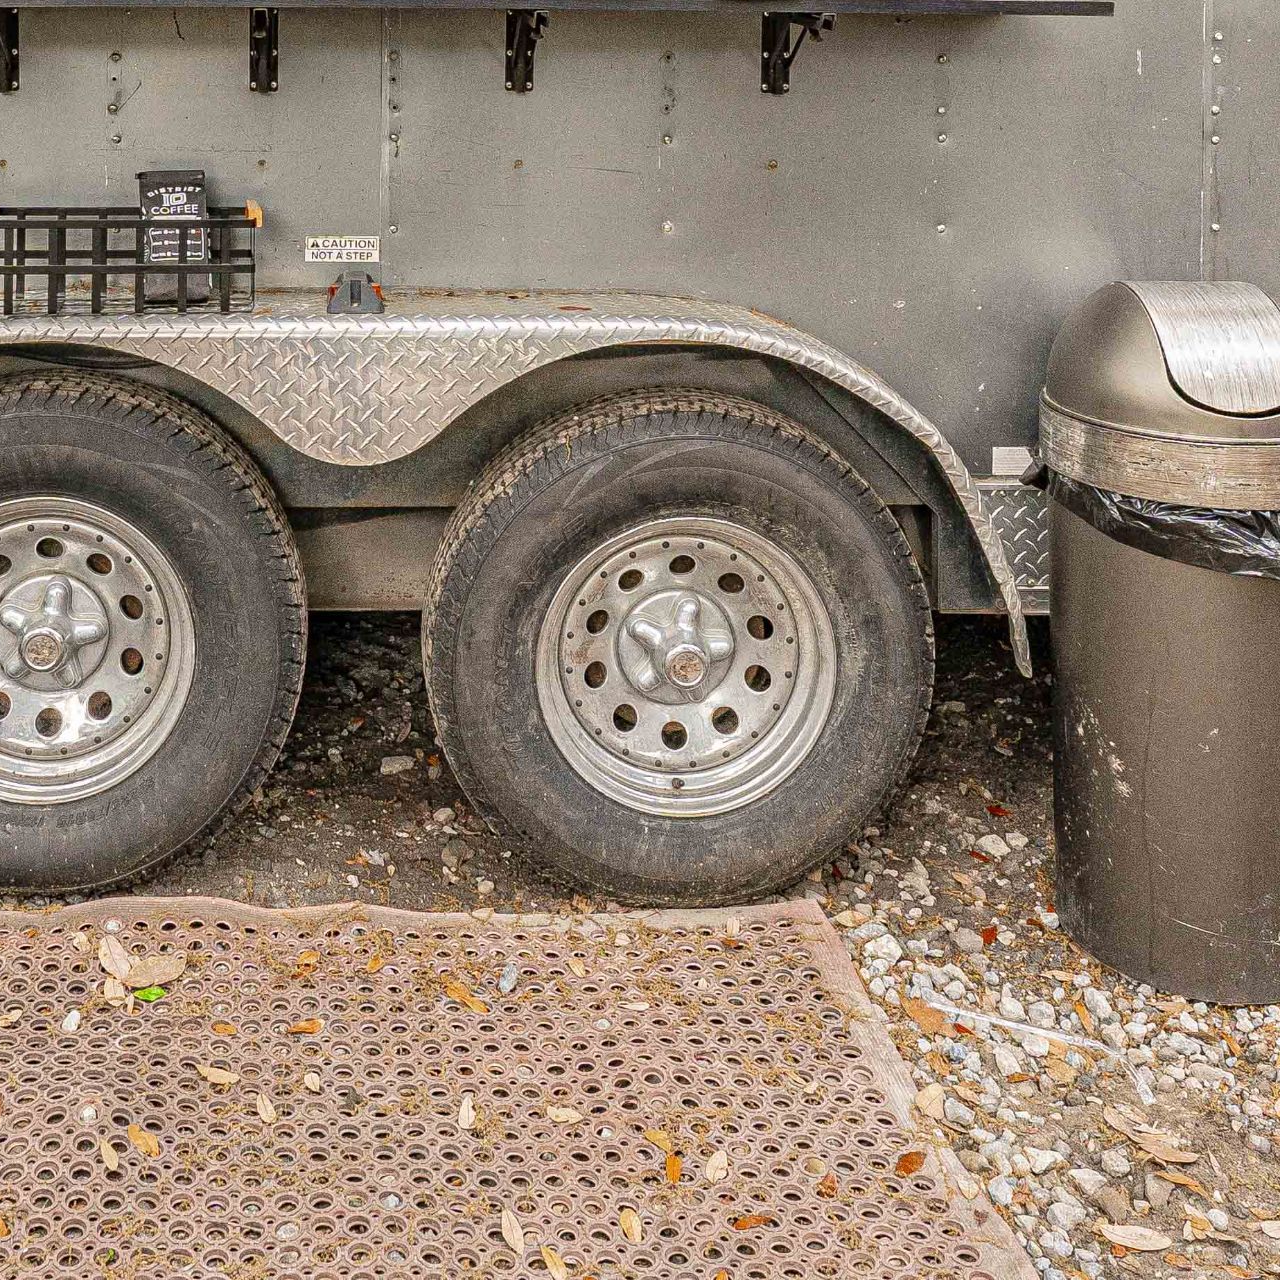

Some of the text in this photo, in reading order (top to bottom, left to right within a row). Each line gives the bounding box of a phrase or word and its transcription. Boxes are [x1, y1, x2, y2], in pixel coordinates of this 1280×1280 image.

[147, 186, 201, 198] DISTRICT
[161, 192, 187, 207] 10
[151, 204, 199, 215] COFFEE
[322, 238, 376, 250] CAUTION
[311, 251, 373, 261] NOT A STEP
